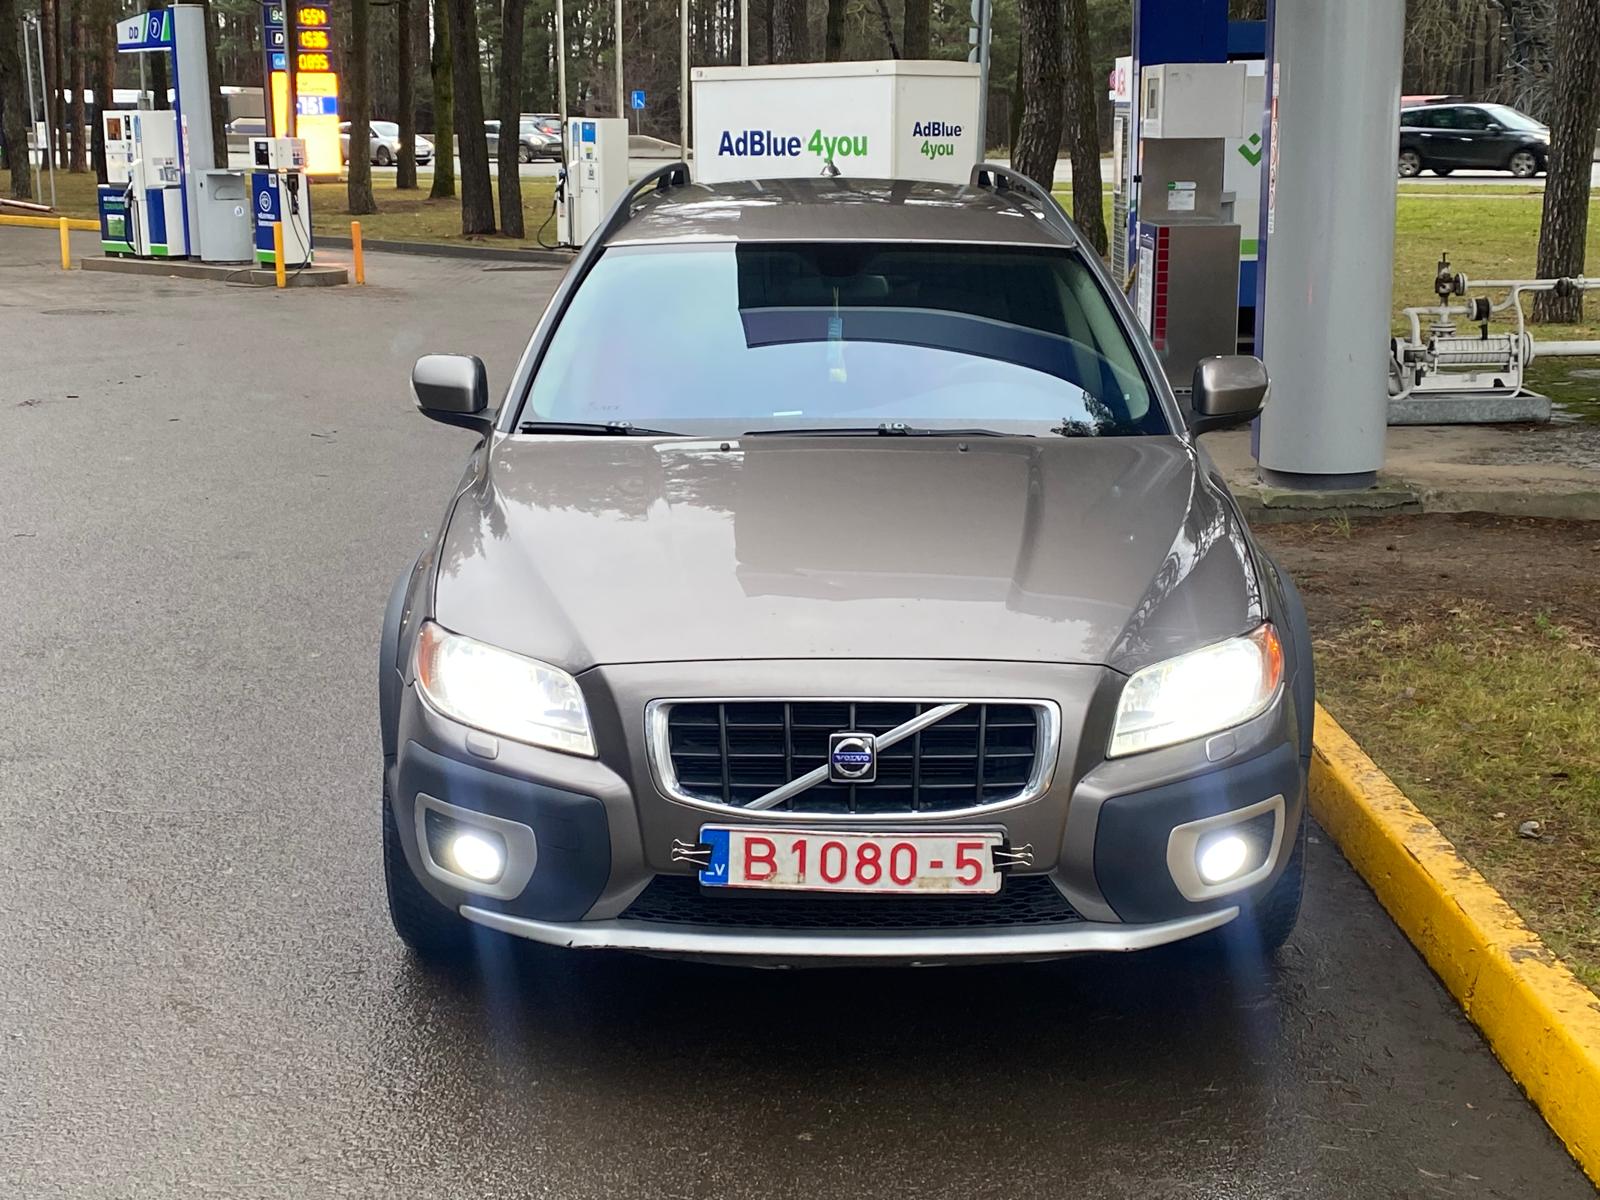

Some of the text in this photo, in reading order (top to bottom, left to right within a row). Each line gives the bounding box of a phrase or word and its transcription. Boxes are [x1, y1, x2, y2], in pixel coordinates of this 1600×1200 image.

[912, 121, 963, 137] AdBlue
[718, 129, 868, 163] AdBlue 4you
[920, 140, 954, 160] 4you
[744, 836, 984, 886] B1080-5
